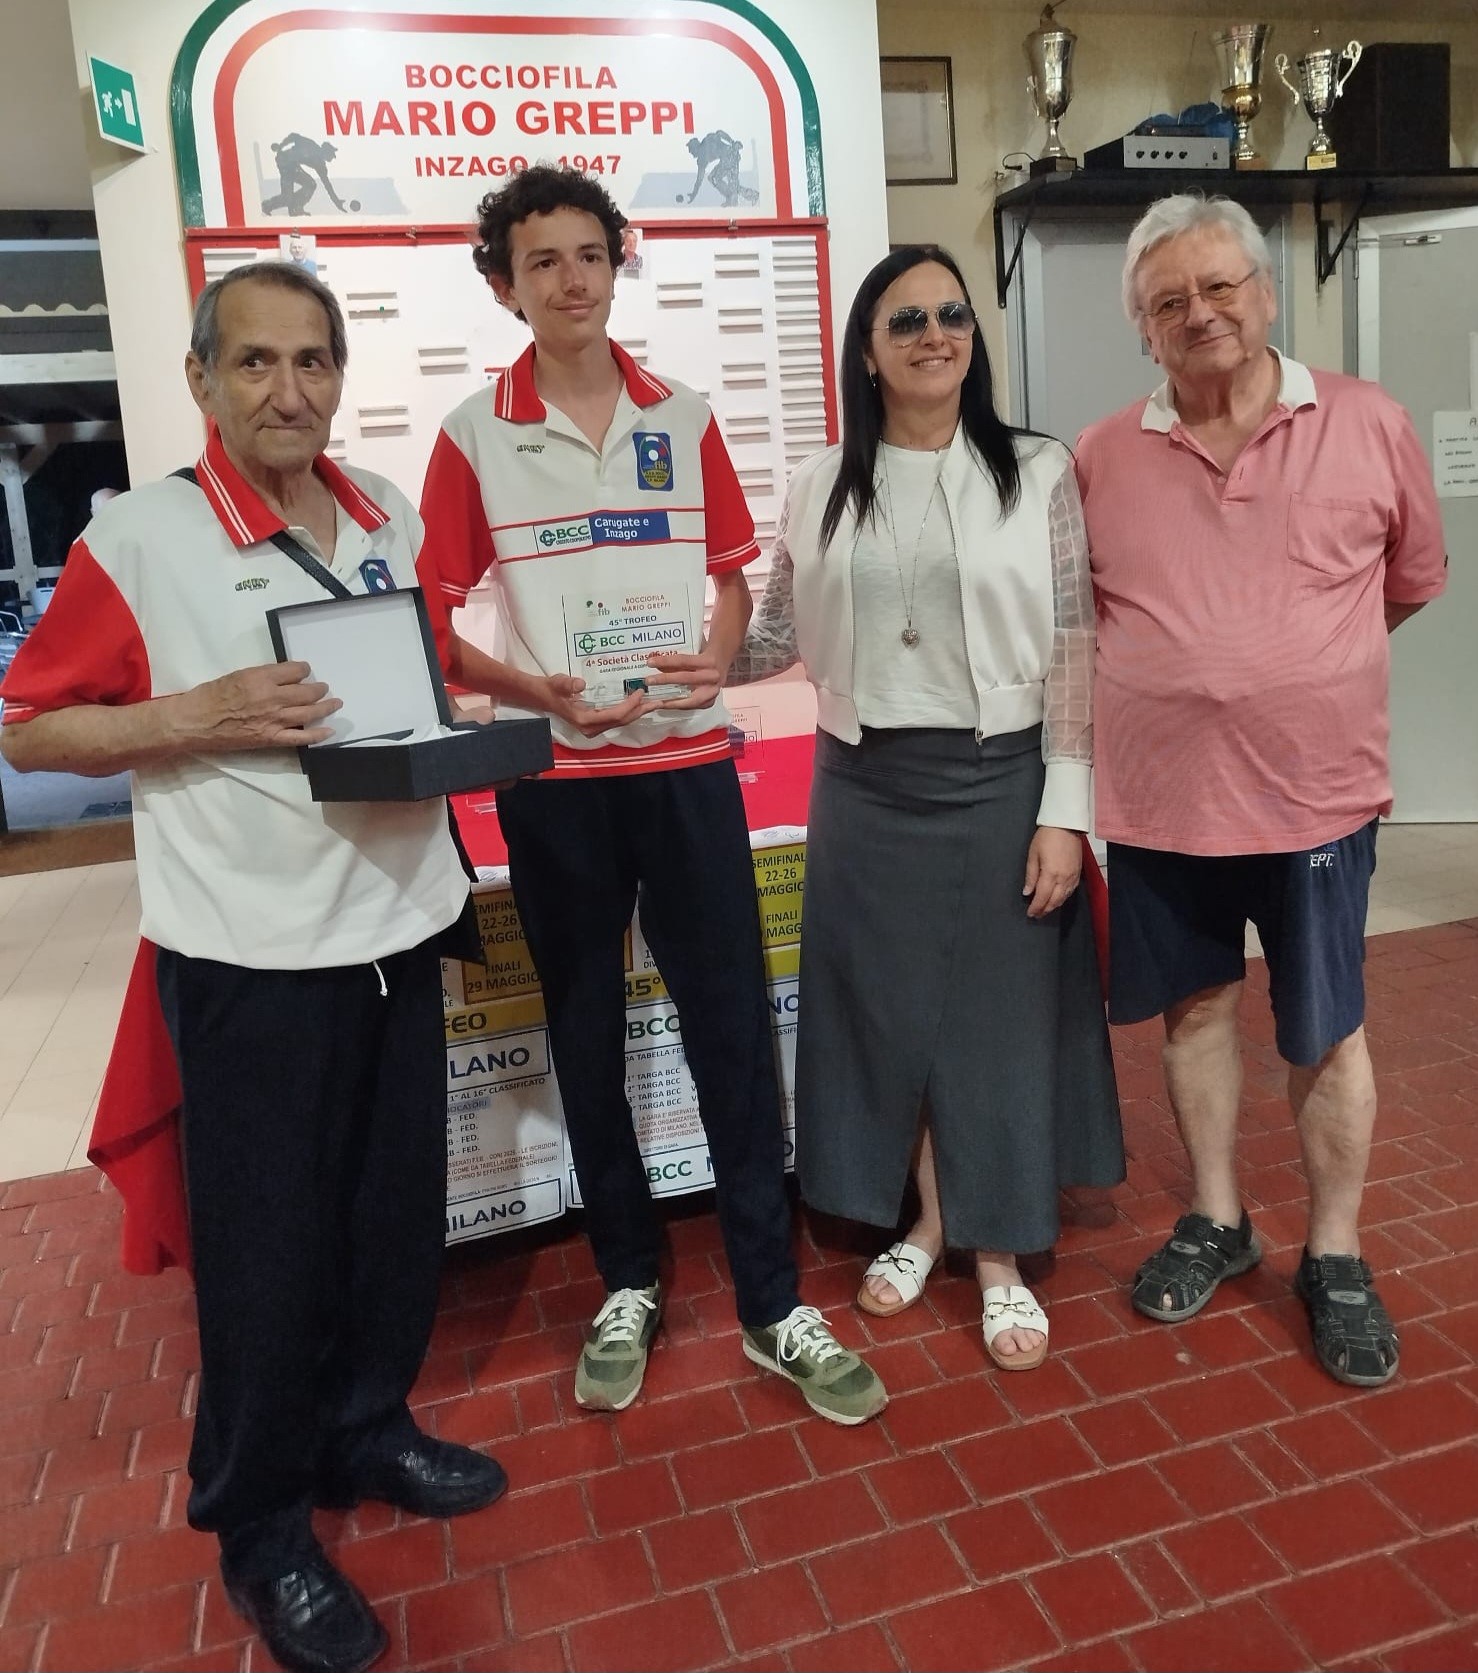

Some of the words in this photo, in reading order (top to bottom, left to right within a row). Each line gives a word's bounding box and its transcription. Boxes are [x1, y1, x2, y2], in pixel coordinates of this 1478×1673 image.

[404, 64, 618, 90] BOCCIOFILA
[323, 100, 497, 136] MARIO
[515, 100, 695, 136] GREPPI
[415, 155, 529, 177] INZAGO
[558, 154, 622, 175] 1947
[594, 517, 641, 529] Carugate
[643, 518, 649, 526] e
[556, 525, 590, 539] BCC
[605, 528, 638, 540] Inzago
[621, 604, 645, 613] MARIO
[647, 601, 671, 610] GREPPI
[624, 615, 657, 625] TROFEO
[600, 635, 625, 647] BCC
[632, 628, 682, 644] MILANO
[597, 656, 629, 667] Società
[765, 867, 797, 882] 22-26
[481, 914, 518, 930] 22-26
[766, 909, 798, 924] FINALI
[467, 981, 481, 994] 29
[627, 1014, 680, 1040] BCC
[637, 1049, 670, 1061] TABELLA
[449, 1047, 530, 1079] LANO
[637, 1071, 663, 1081] TARGA
[665, 1067, 681, 1076] BCC
[460, 1092, 472, 1101] AL
[488, 1077, 546, 1095] CLASSIFICATO
[637, 1080, 664, 1091] TARGA
[665, 1077, 681, 1087] BCC
[638, 1091, 665, 1101] TARGA
[666, 1087, 682, 1097] BCC
[638, 1101, 665, 1111] TARGA
[666, 1097, 682, 1107] BCC
[460, 1123, 478, 1133] FED.
[461, 1133, 480, 1144] FED.
[462, 1144, 481, 1154] FED.
[646, 1160, 692, 1183] BCC
